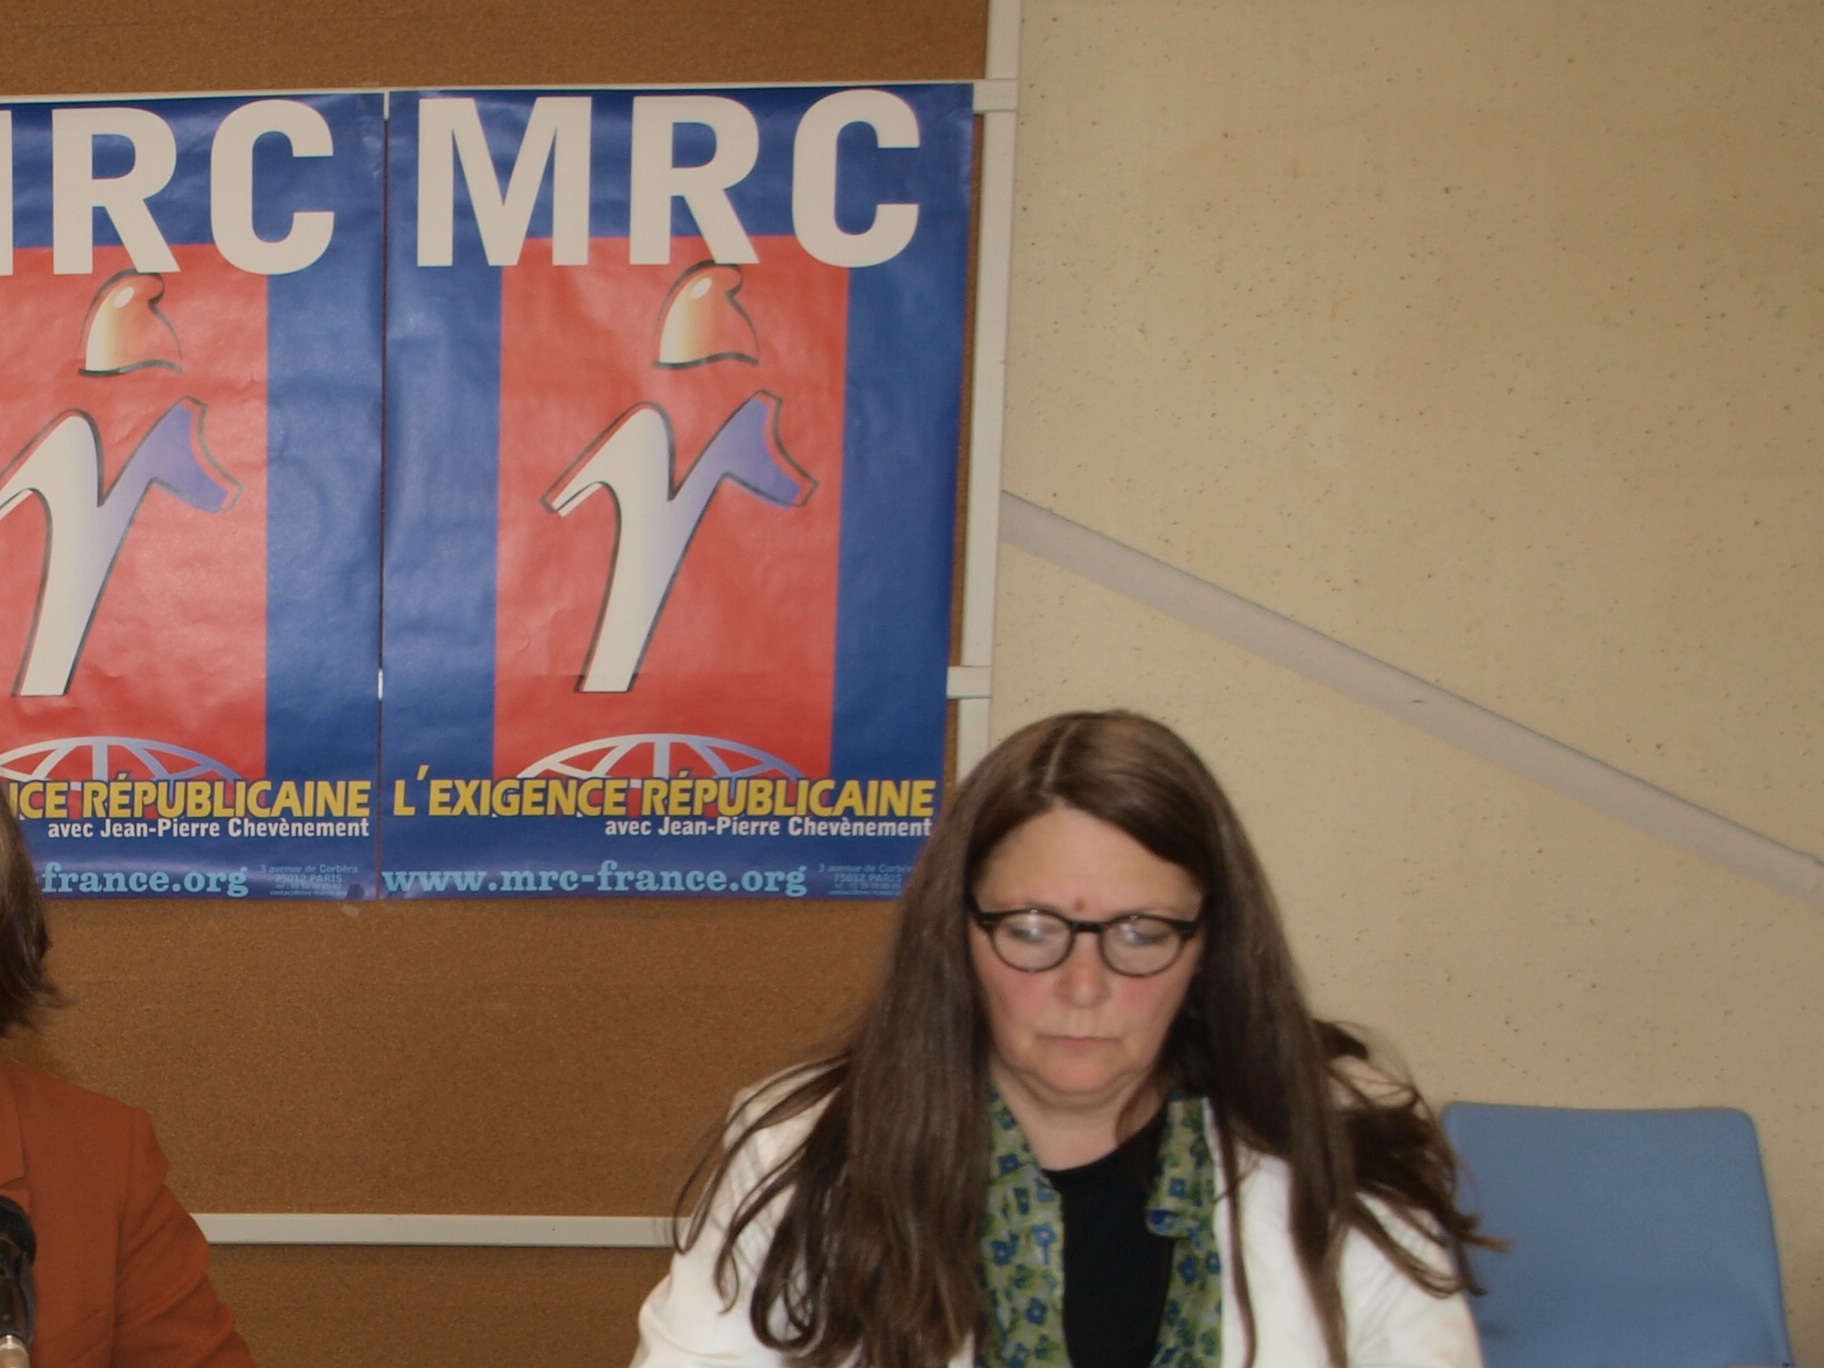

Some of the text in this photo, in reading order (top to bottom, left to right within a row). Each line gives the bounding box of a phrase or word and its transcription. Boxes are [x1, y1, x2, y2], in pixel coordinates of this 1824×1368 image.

[417, 88, 921, 268] MRC
[82, 772, 372, 819] RÉPUBLICAINE
[393, 764, 937, 817] L'EXIGENCE RÉPUBLICAINE
[48, 817, 370, 838] avec Jean-Pierre Chevènement
[605, 816, 933, 837] avec Jean-Pierre Chevènement
[41, 862, 250, 898] france.org
[309, 874, 343, 884] PARIS
[381, 860, 808, 897] www.mrc-france.org
